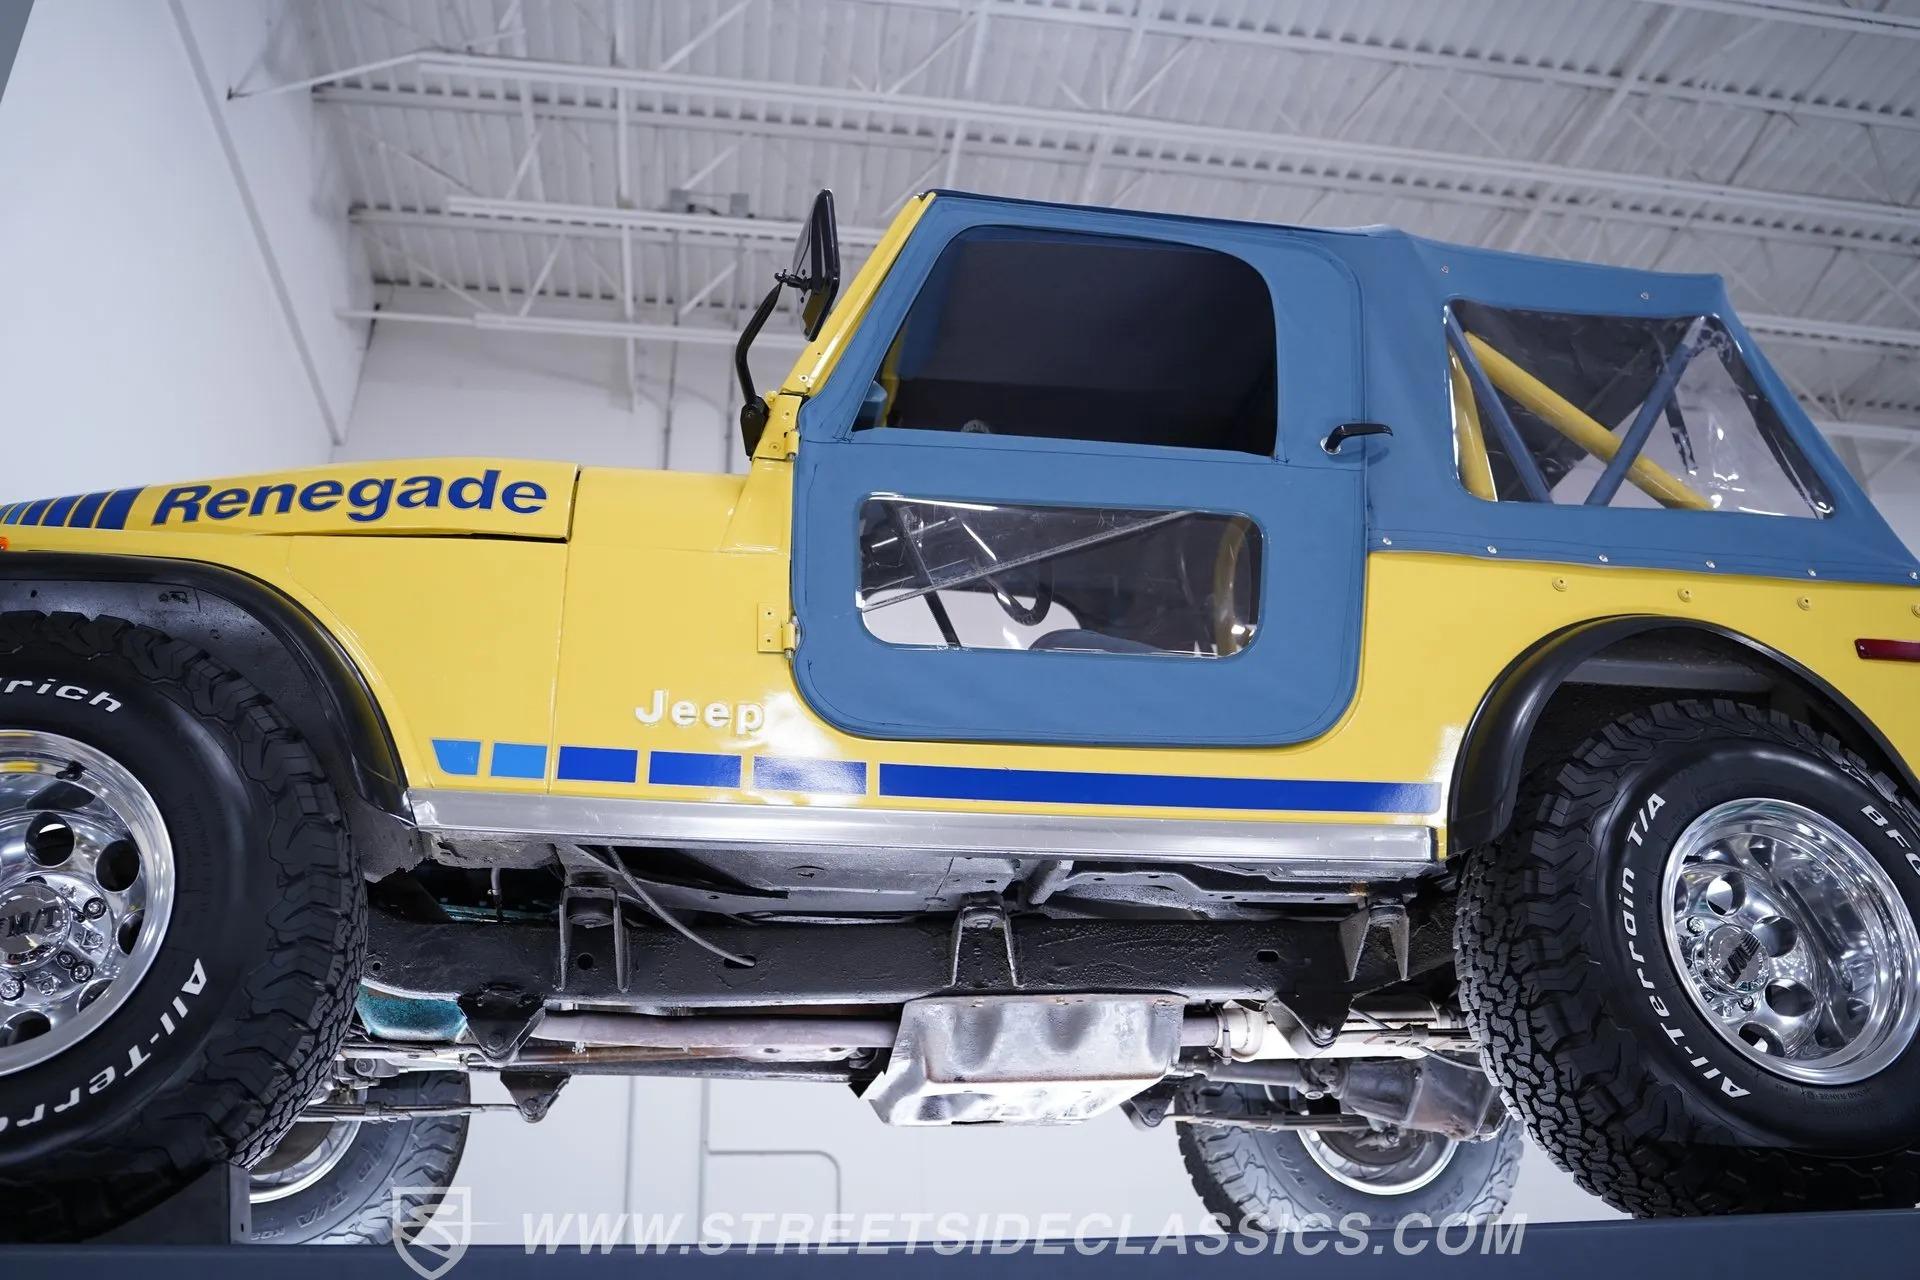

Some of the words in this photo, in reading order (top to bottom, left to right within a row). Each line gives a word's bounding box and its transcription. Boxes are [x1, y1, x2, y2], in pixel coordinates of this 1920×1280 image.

[151, 469, 548, 522] Renegade
[0, 678, 122, 712] rich
[634, 688, 765, 735] Jeep
[1626, 792, 1666, 847] T/A
